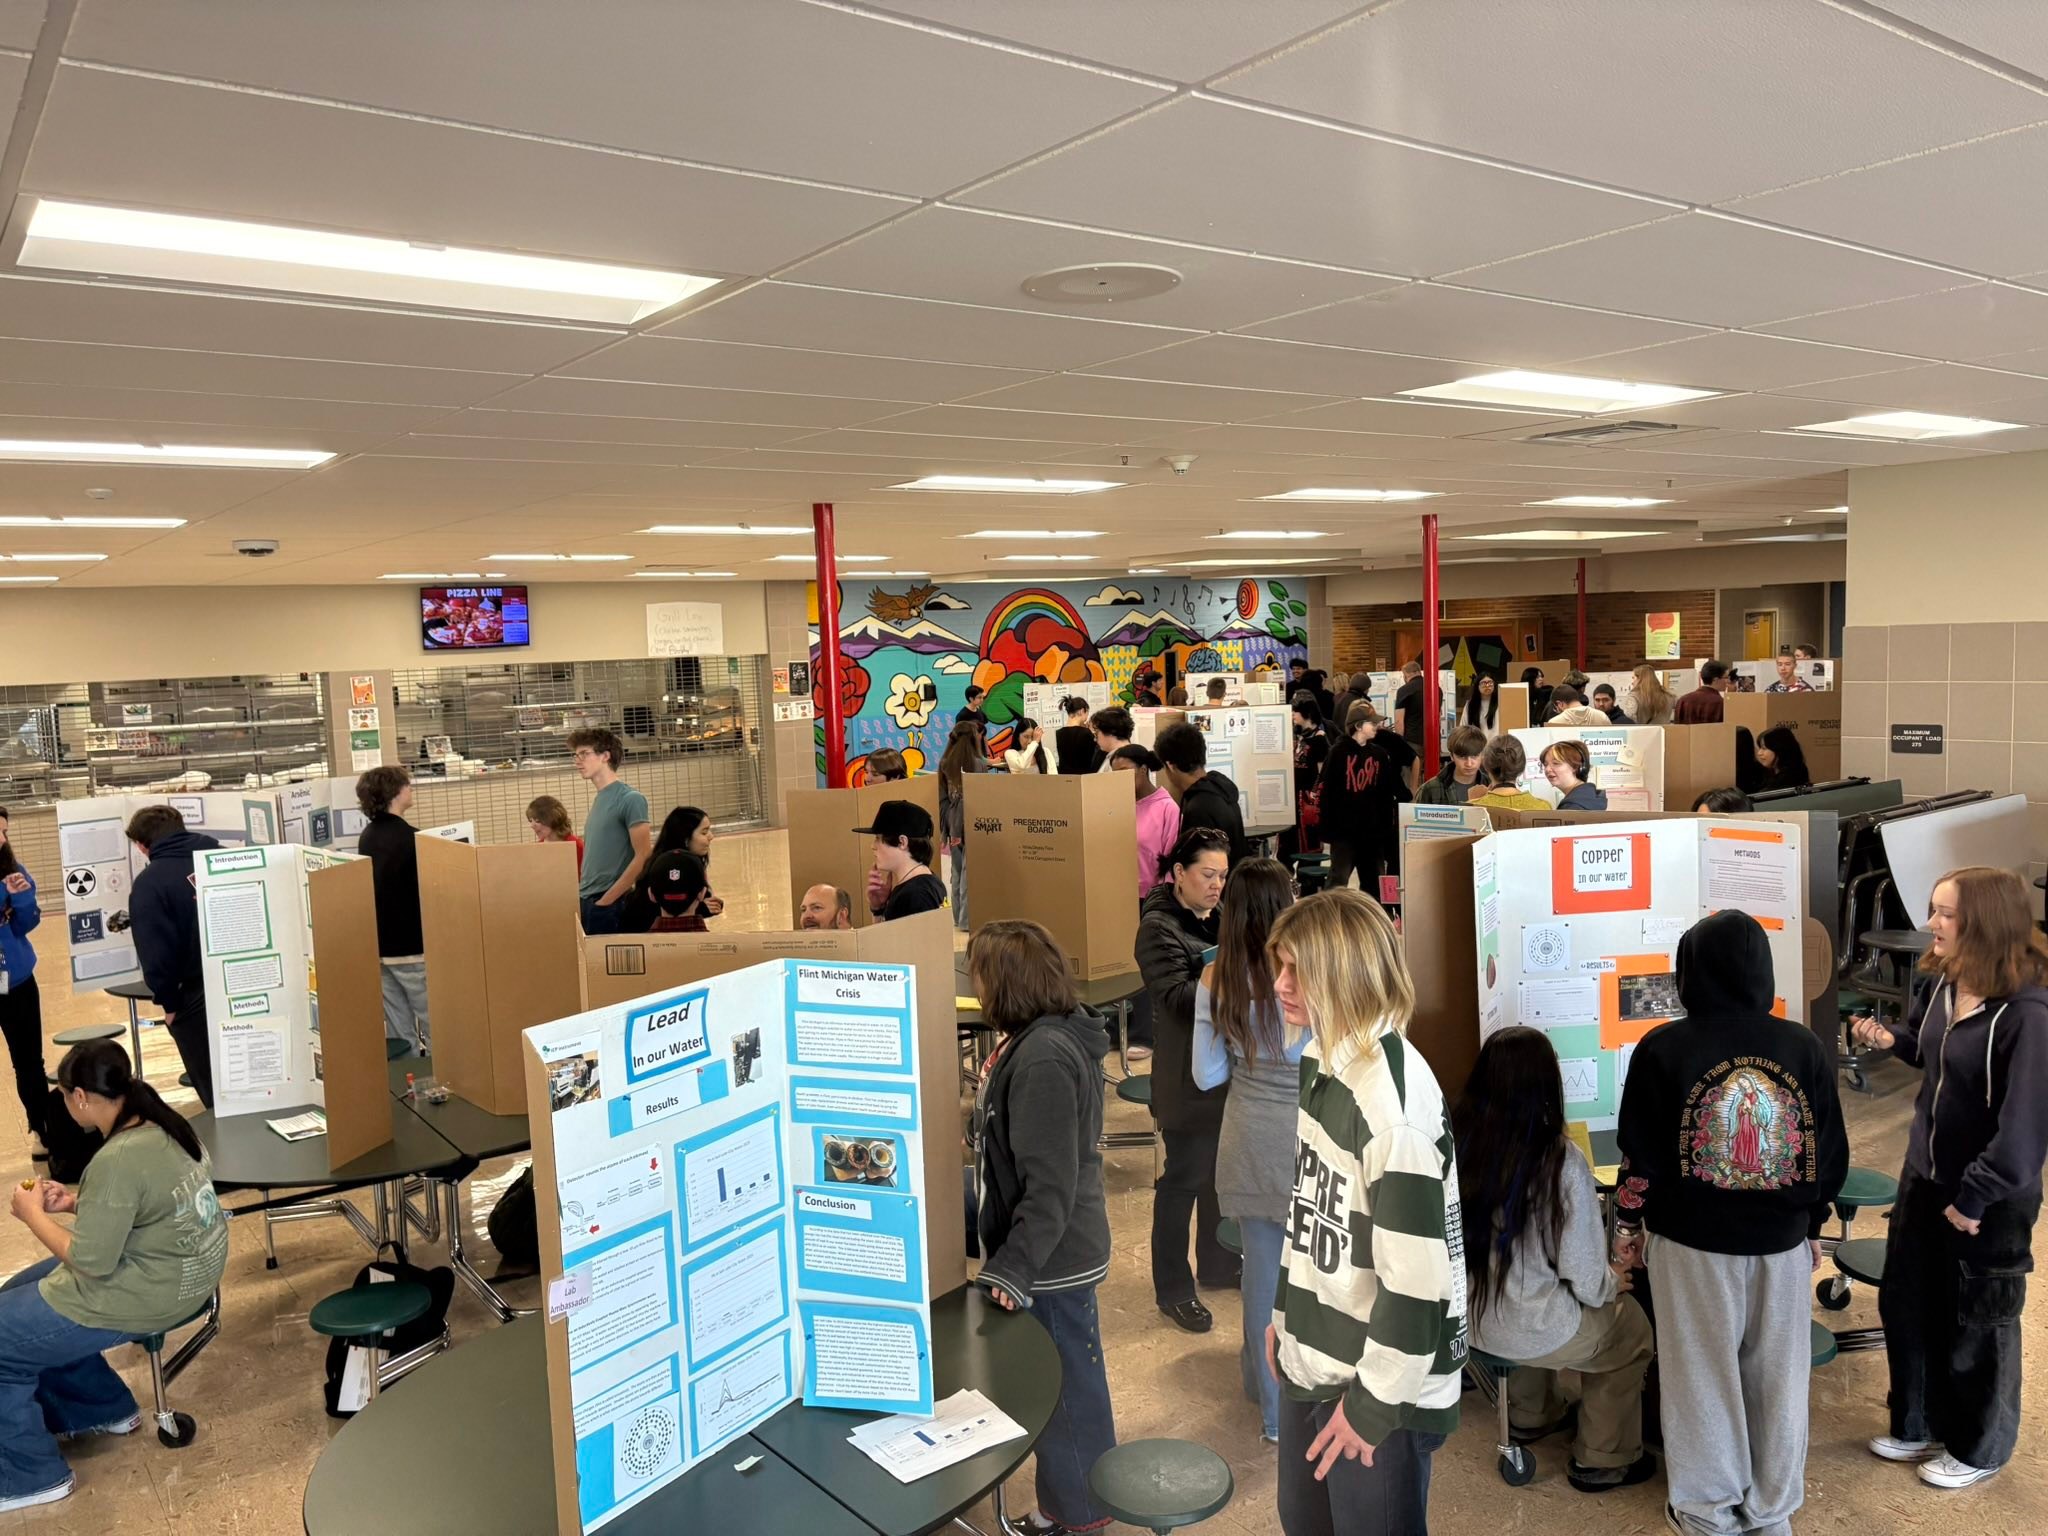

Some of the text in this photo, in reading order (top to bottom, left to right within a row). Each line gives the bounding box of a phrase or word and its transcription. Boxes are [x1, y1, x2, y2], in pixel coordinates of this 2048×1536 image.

[446, 587, 503, 598] PIZZA LINE
[1583, 738, 1622, 746] Cadmium
[1420, 811, 1458, 819] Introduction
[316, 820, 325, 829] As
[973, 822, 1002, 835] SMART
[1013, 818, 1068, 828] PRESENTATION
[1027, 826, 1054, 834] BOARD
[214, 853, 259, 865] Introduction
[81, 918, 90, 929] U
[798, 968, 898, 983] Flint Michigan Water
[835, 988, 861, 998] Crisis
[233, 999, 265, 1011] Methods
[647, 1002, 691, 1032] Lead
[222, 1023, 253, 1032] Methods
[632, 1035, 704, 1069] In our Water
[1733, 1055, 1783, 1074] NOTHING
[1702, 1060, 1732, 1083] FROM
[1781, 1071, 1800, 1090] AND
[1685, 1080, 1707, 1106] CAME
[645, 1096, 679, 1115] Results
[1803, 1129, 1818, 1183] SOMETHING
[1681, 1158, 1690, 1178] FOR
[566, 1174, 585, 1184] Detector
[804, 1195, 856, 1211] Conclusion
[564, 1286, 577, 1297] Lab
[550, 1295, 590, 1315] Ambassador
